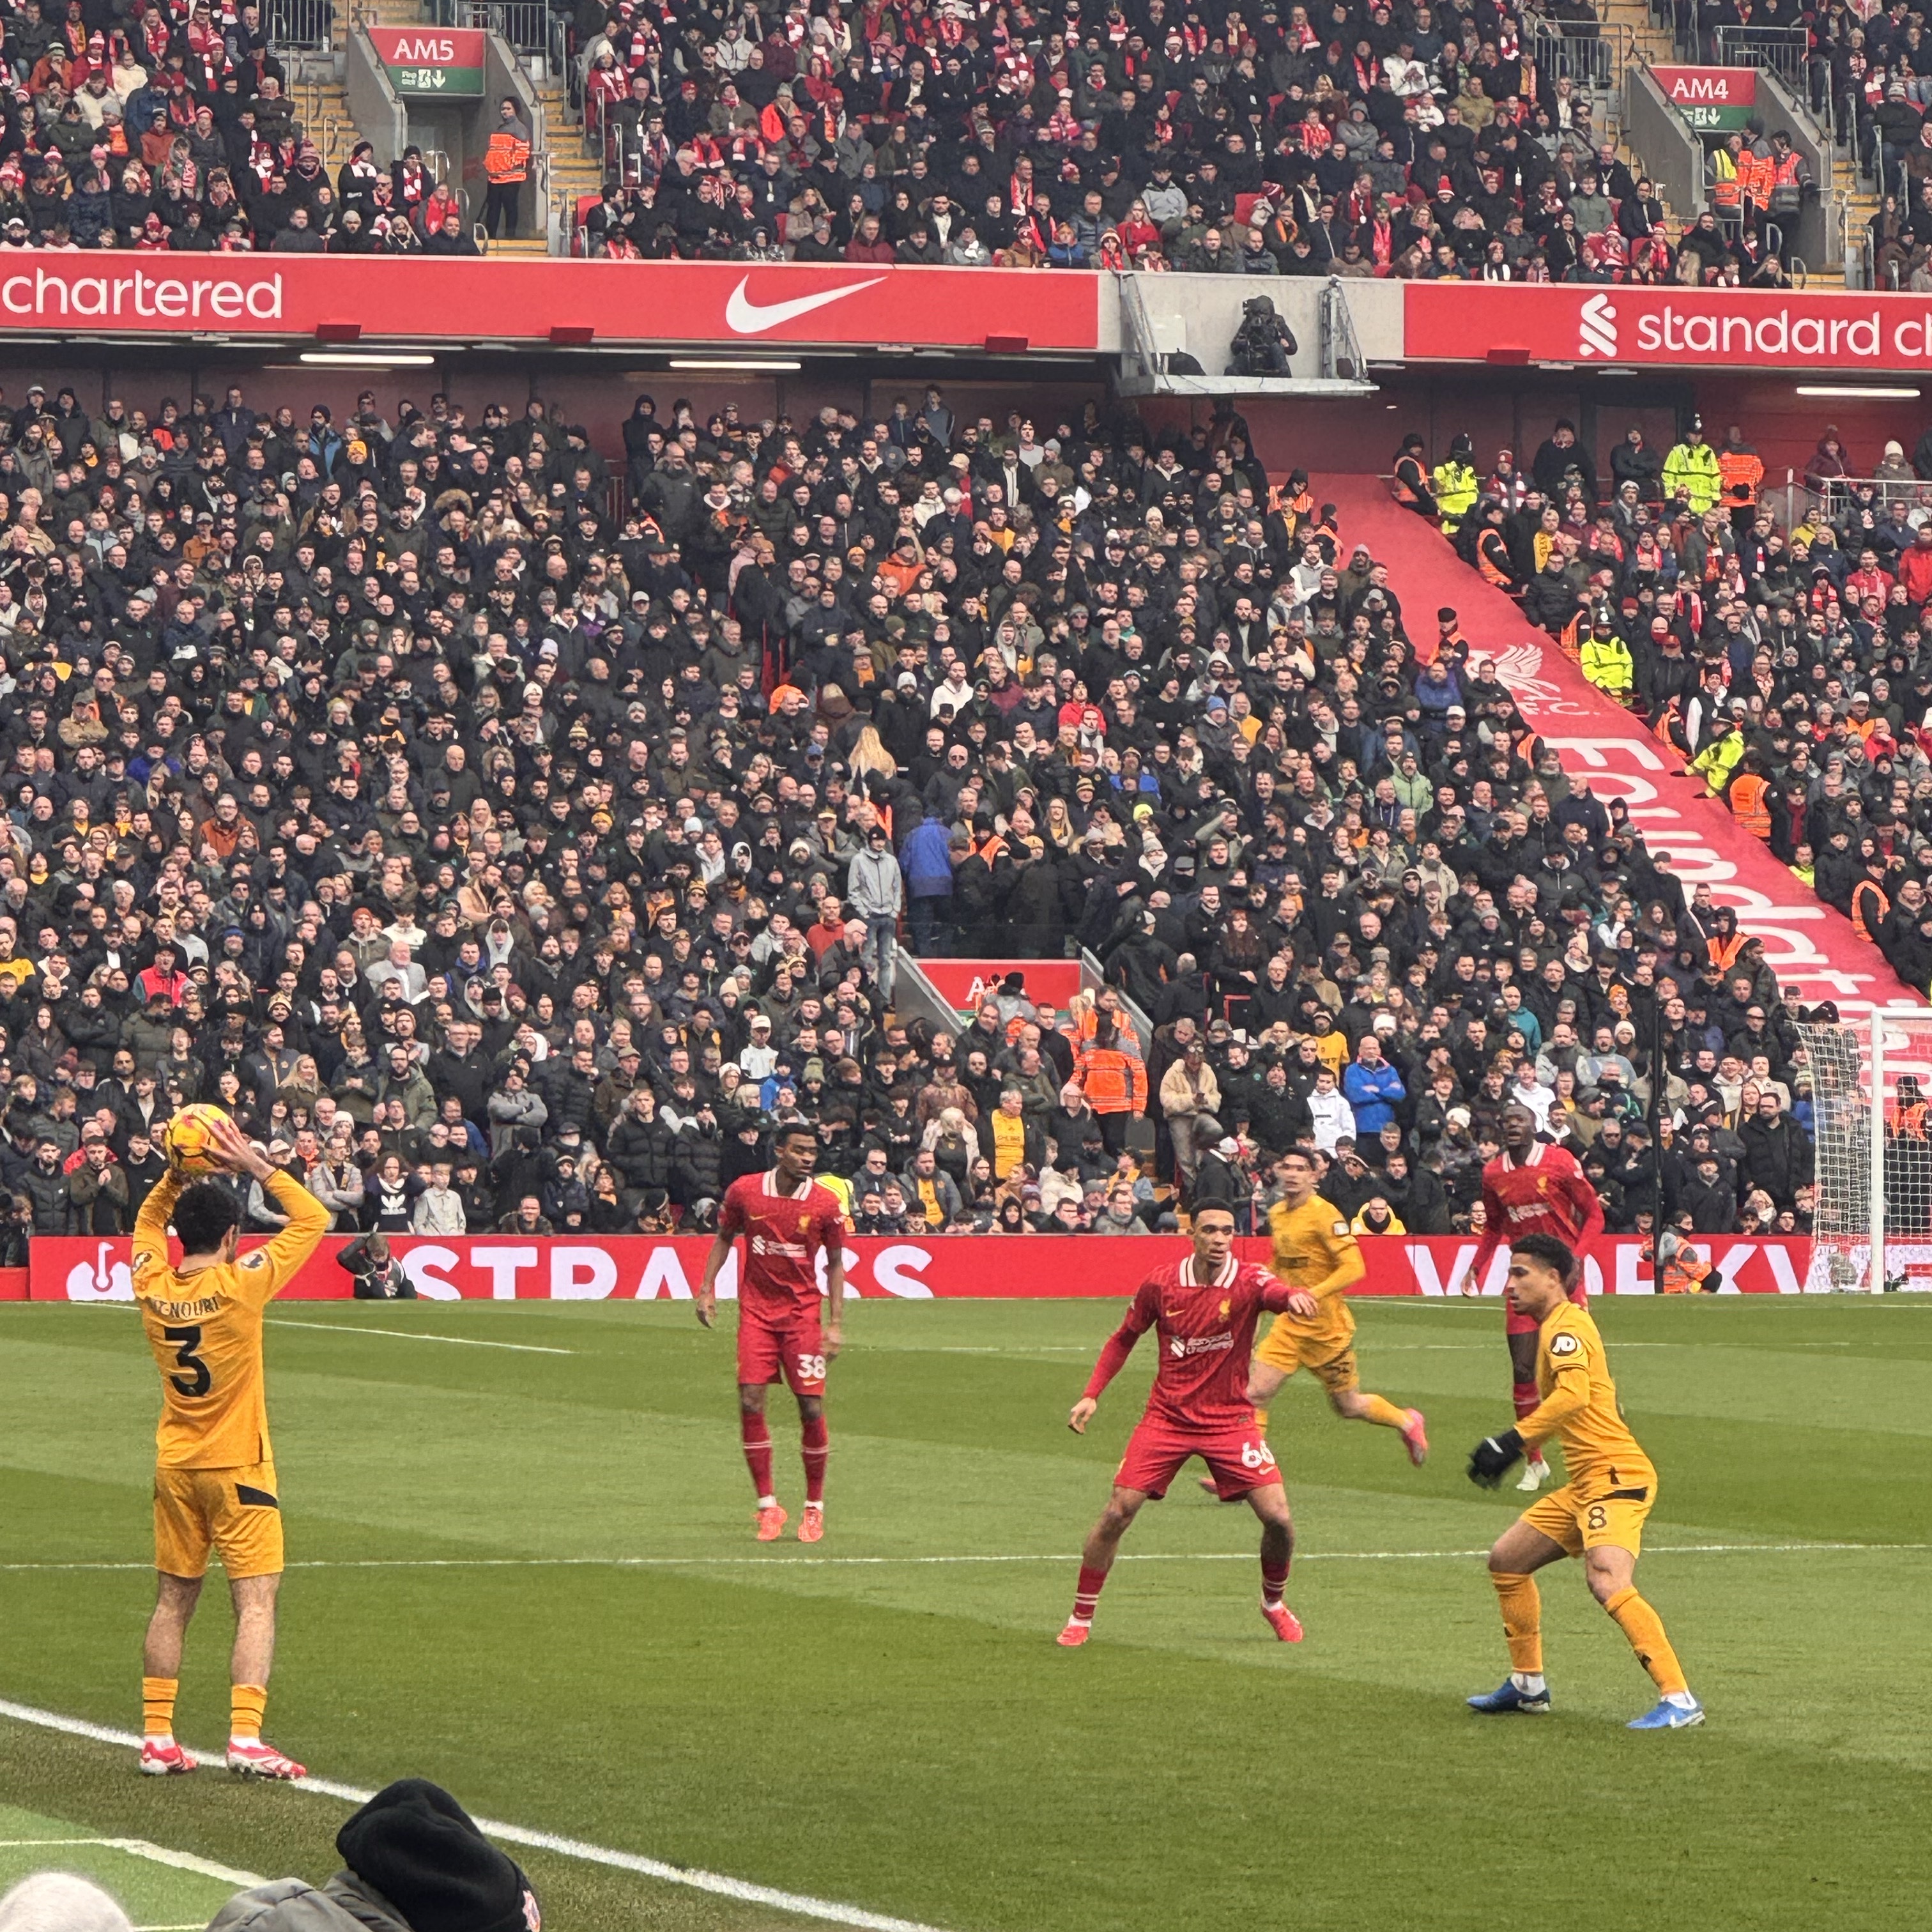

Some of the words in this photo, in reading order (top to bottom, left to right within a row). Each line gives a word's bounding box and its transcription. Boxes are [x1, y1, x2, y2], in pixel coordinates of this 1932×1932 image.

[393, 38, 454, 61] AM5
[1670, 78, 1729, 99] AM4
[2, 267, 282, 319] chartered
[1637, 306, 1880, 356] standard
[164, 1326, 211, 1397] 3
[797, 1354, 826, 1379] 38
[1588, 1506, 1607, 1530] 8
